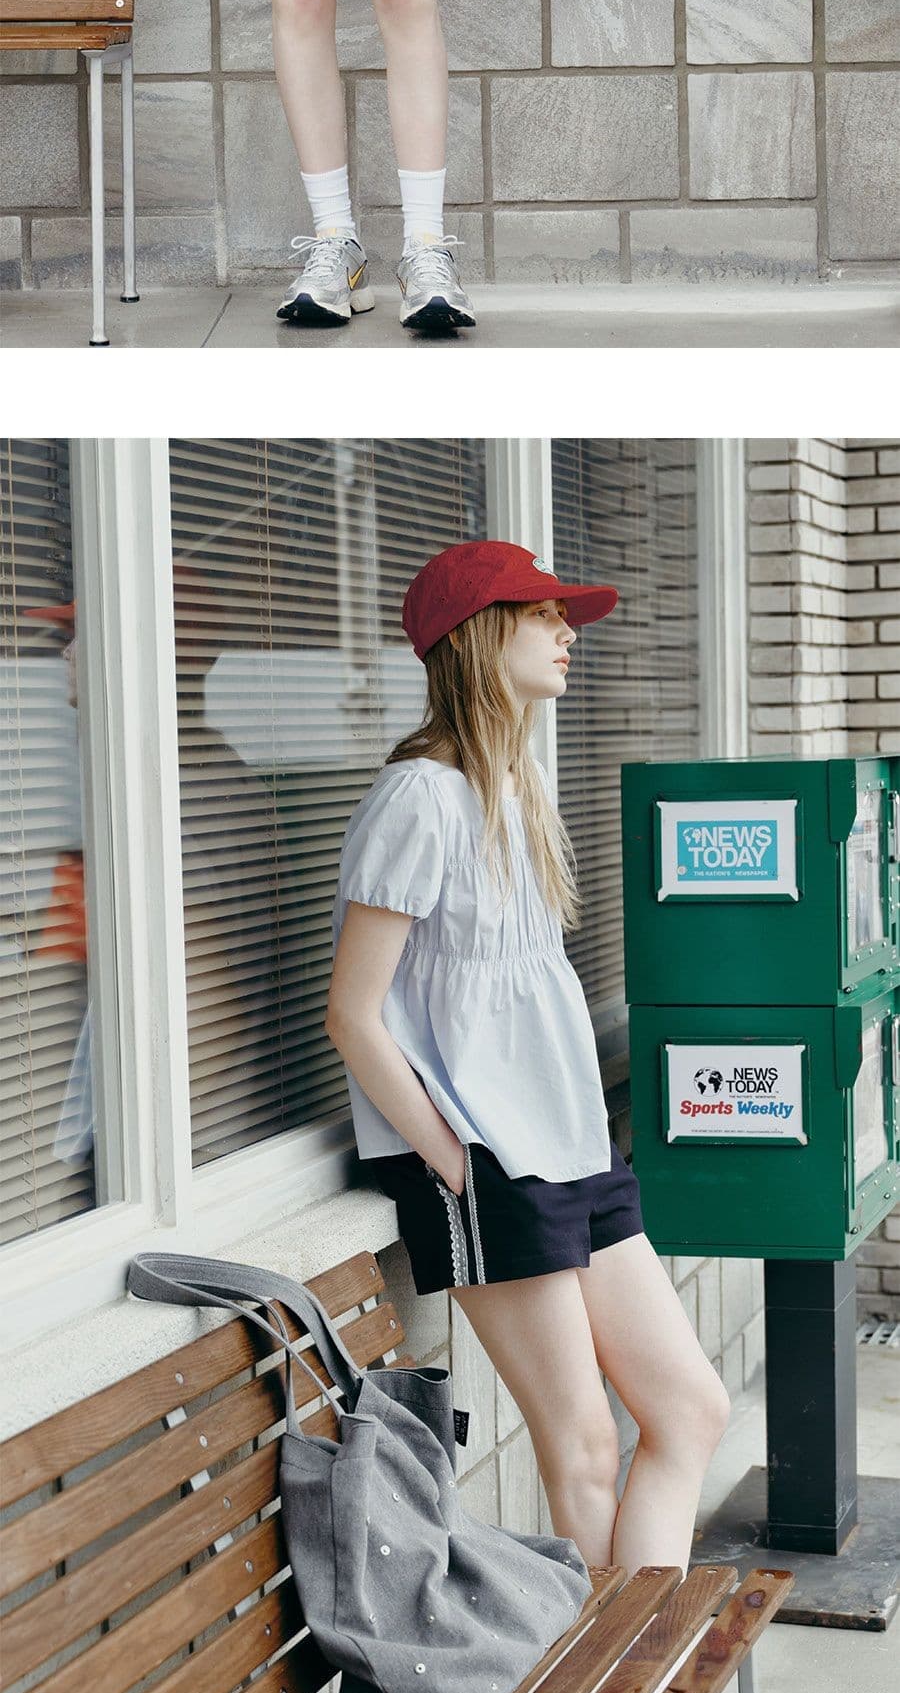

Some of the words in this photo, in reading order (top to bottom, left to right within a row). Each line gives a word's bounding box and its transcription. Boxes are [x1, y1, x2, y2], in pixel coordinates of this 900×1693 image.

[701, 825, 772, 848] NEWS
[688, 846, 766, 868] TODAY
[733, 1067, 778, 1081] NEWS
[726, 1080, 775, 1093] TODAY
[680, 1099, 733, 1117] Sports
[737, 1100, 794, 1119] Weekly
